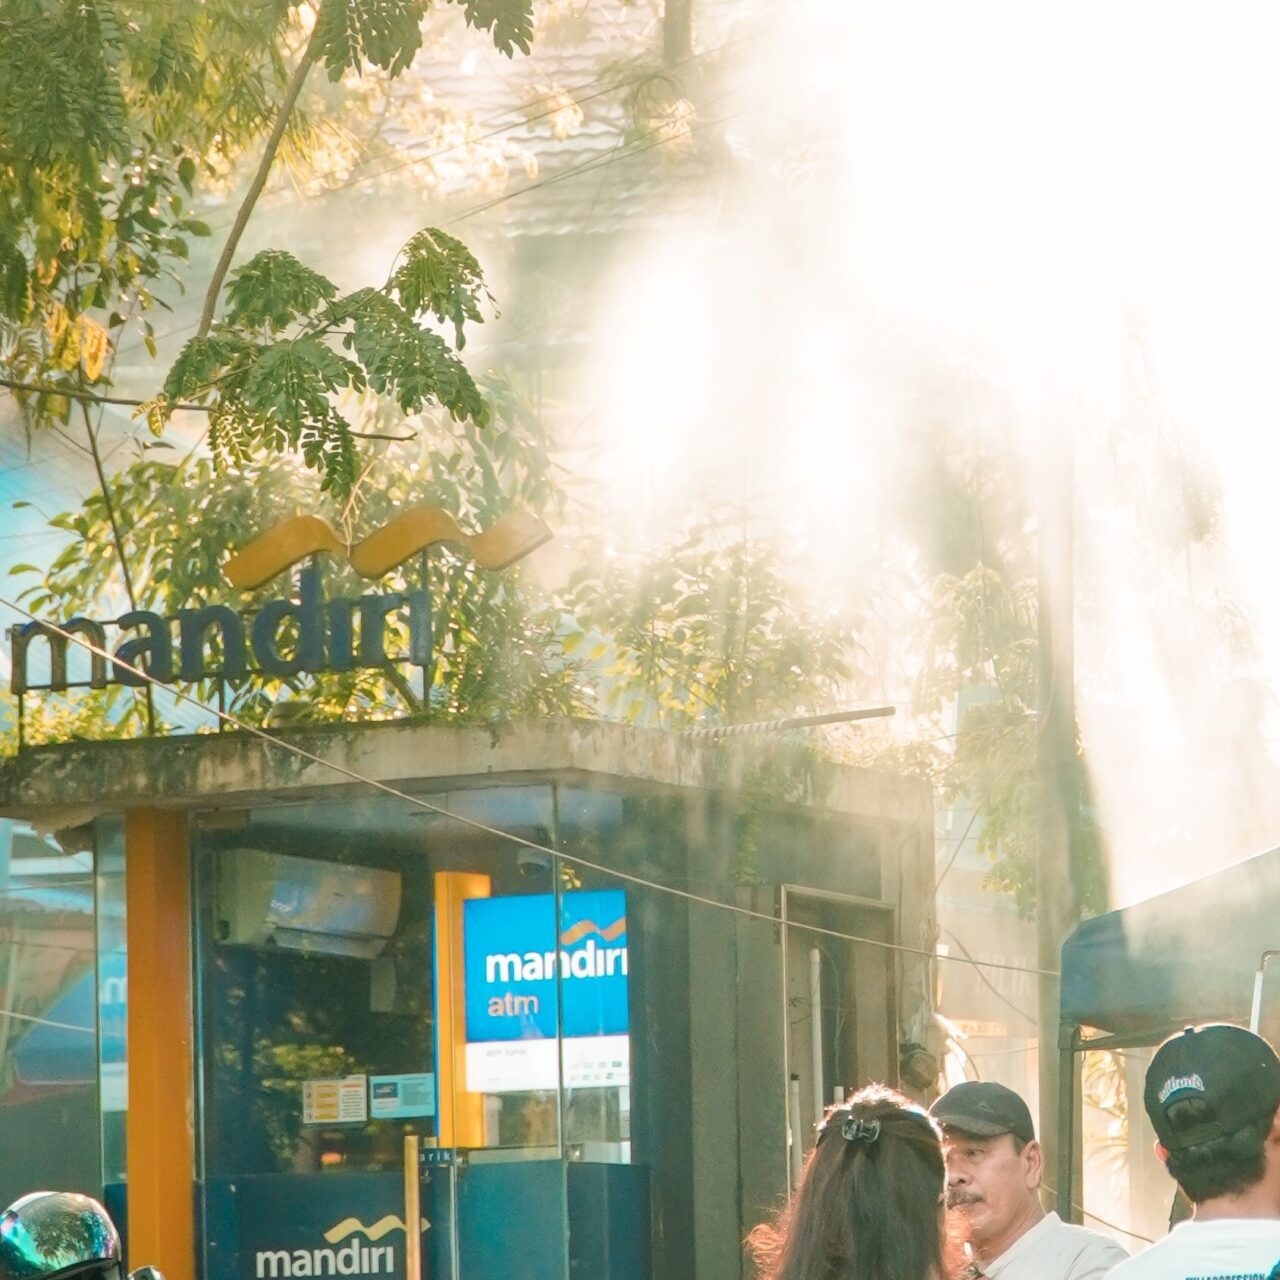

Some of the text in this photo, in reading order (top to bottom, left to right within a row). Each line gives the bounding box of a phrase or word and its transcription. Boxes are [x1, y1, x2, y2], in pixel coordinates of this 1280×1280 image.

[11, 566, 432, 694] mandiri
[486, 939, 628, 983] mandiri
[487, 992, 539, 1018] atm
[256, 1238, 394, 1278] mandiri
